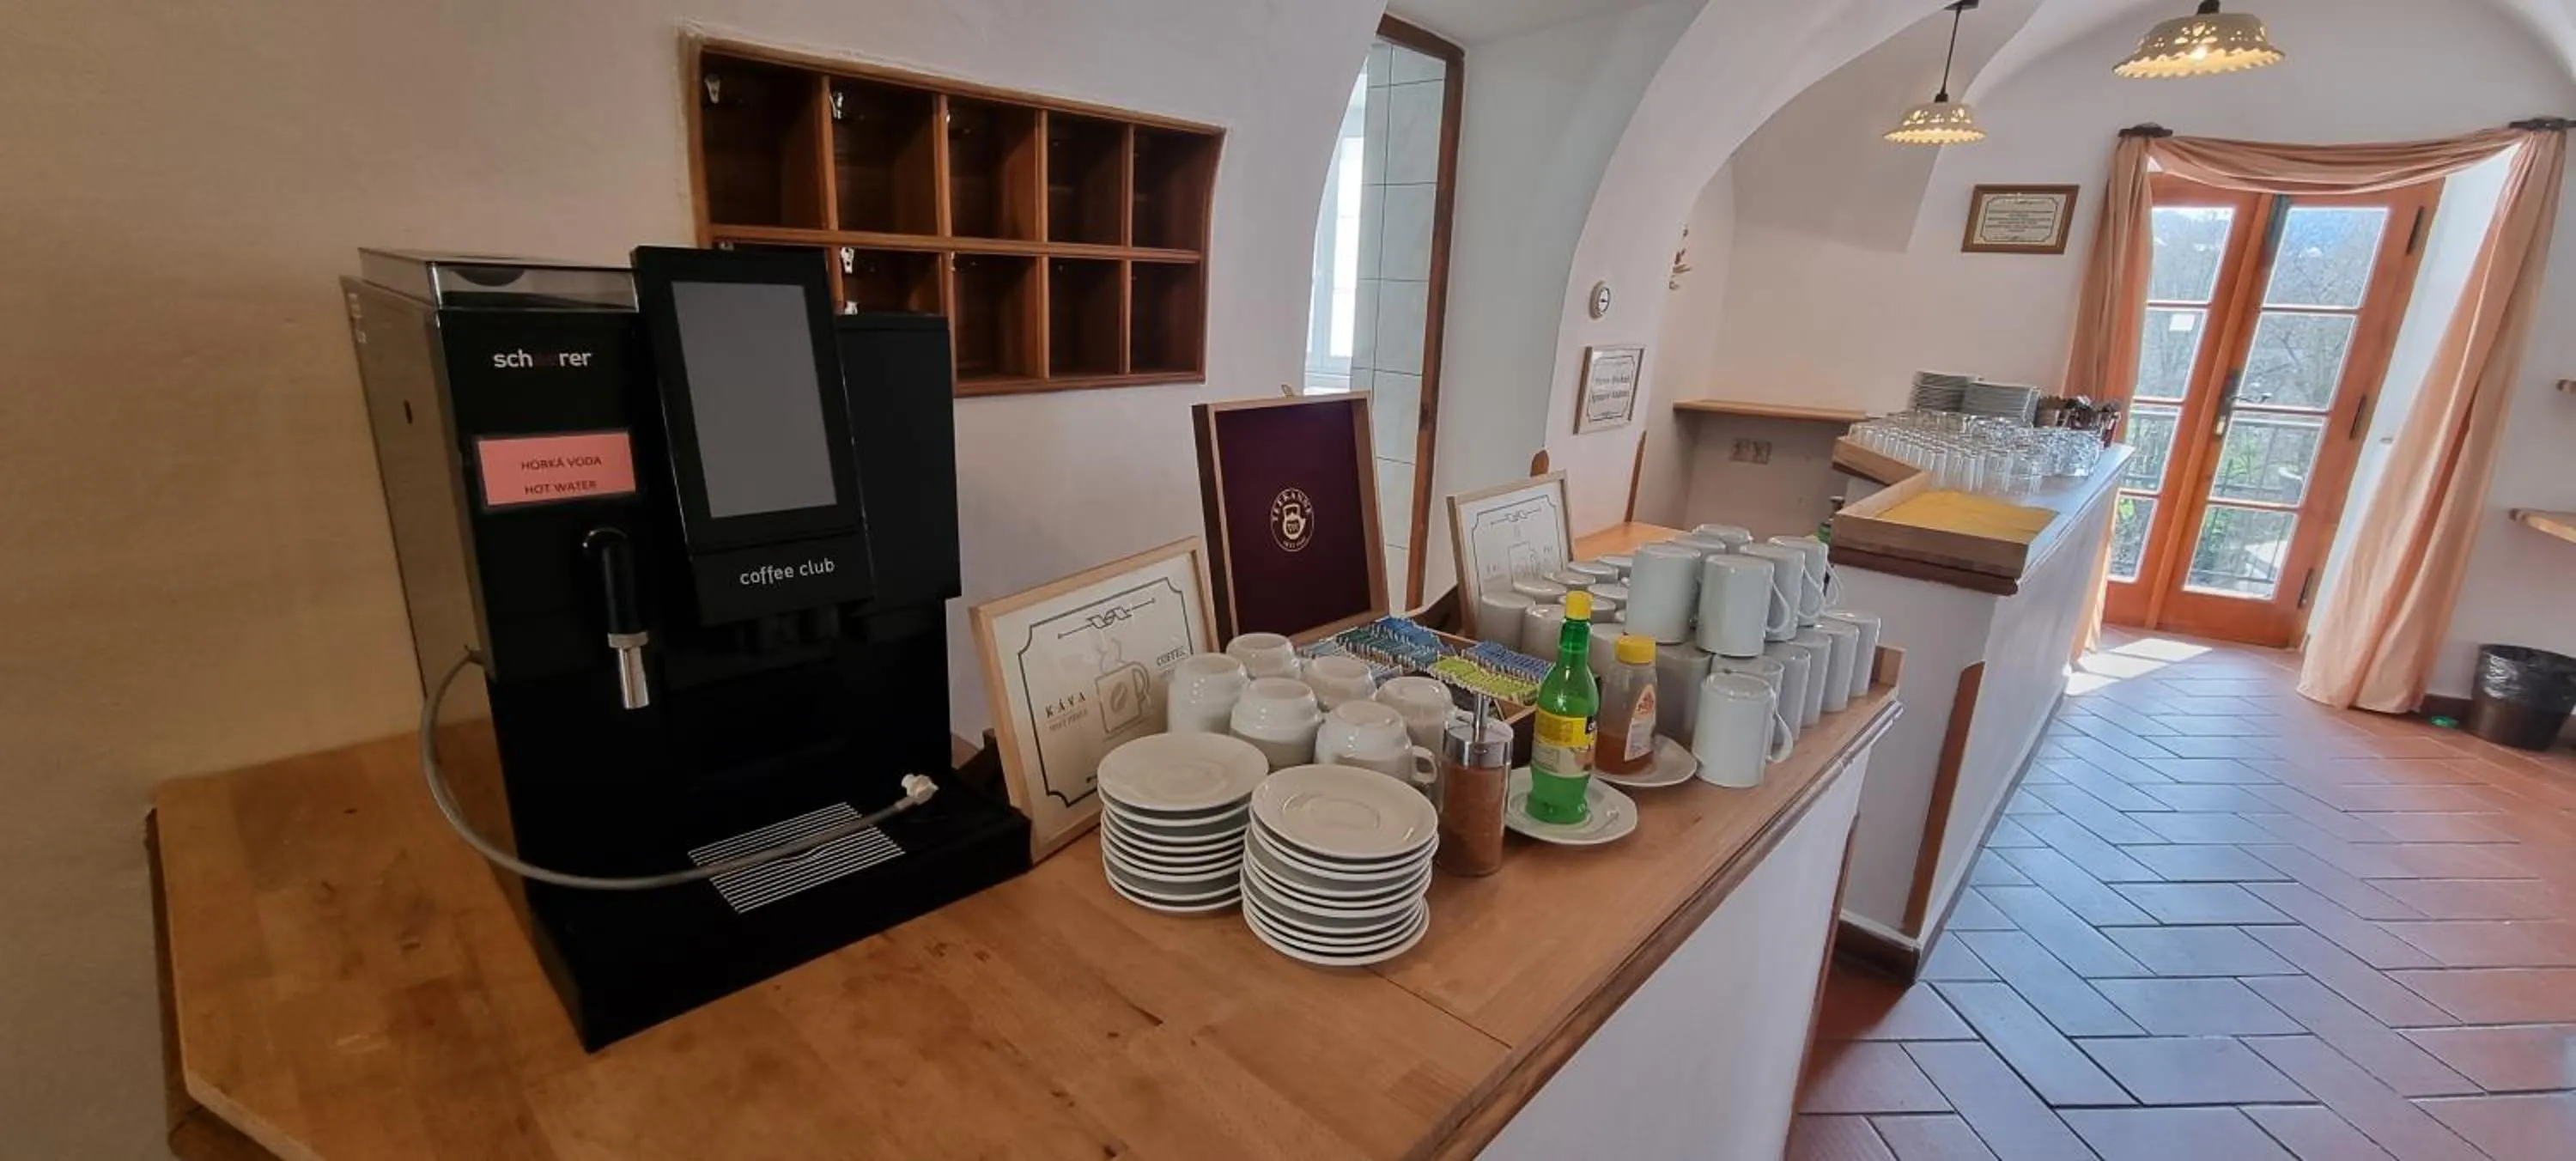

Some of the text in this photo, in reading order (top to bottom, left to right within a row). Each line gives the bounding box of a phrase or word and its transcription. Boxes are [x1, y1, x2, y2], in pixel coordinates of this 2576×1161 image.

[568, 455, 603, 468] VODA
[524, 478, 598, 495] HOT WATER
[739, 557, 835, 585] coffee club
